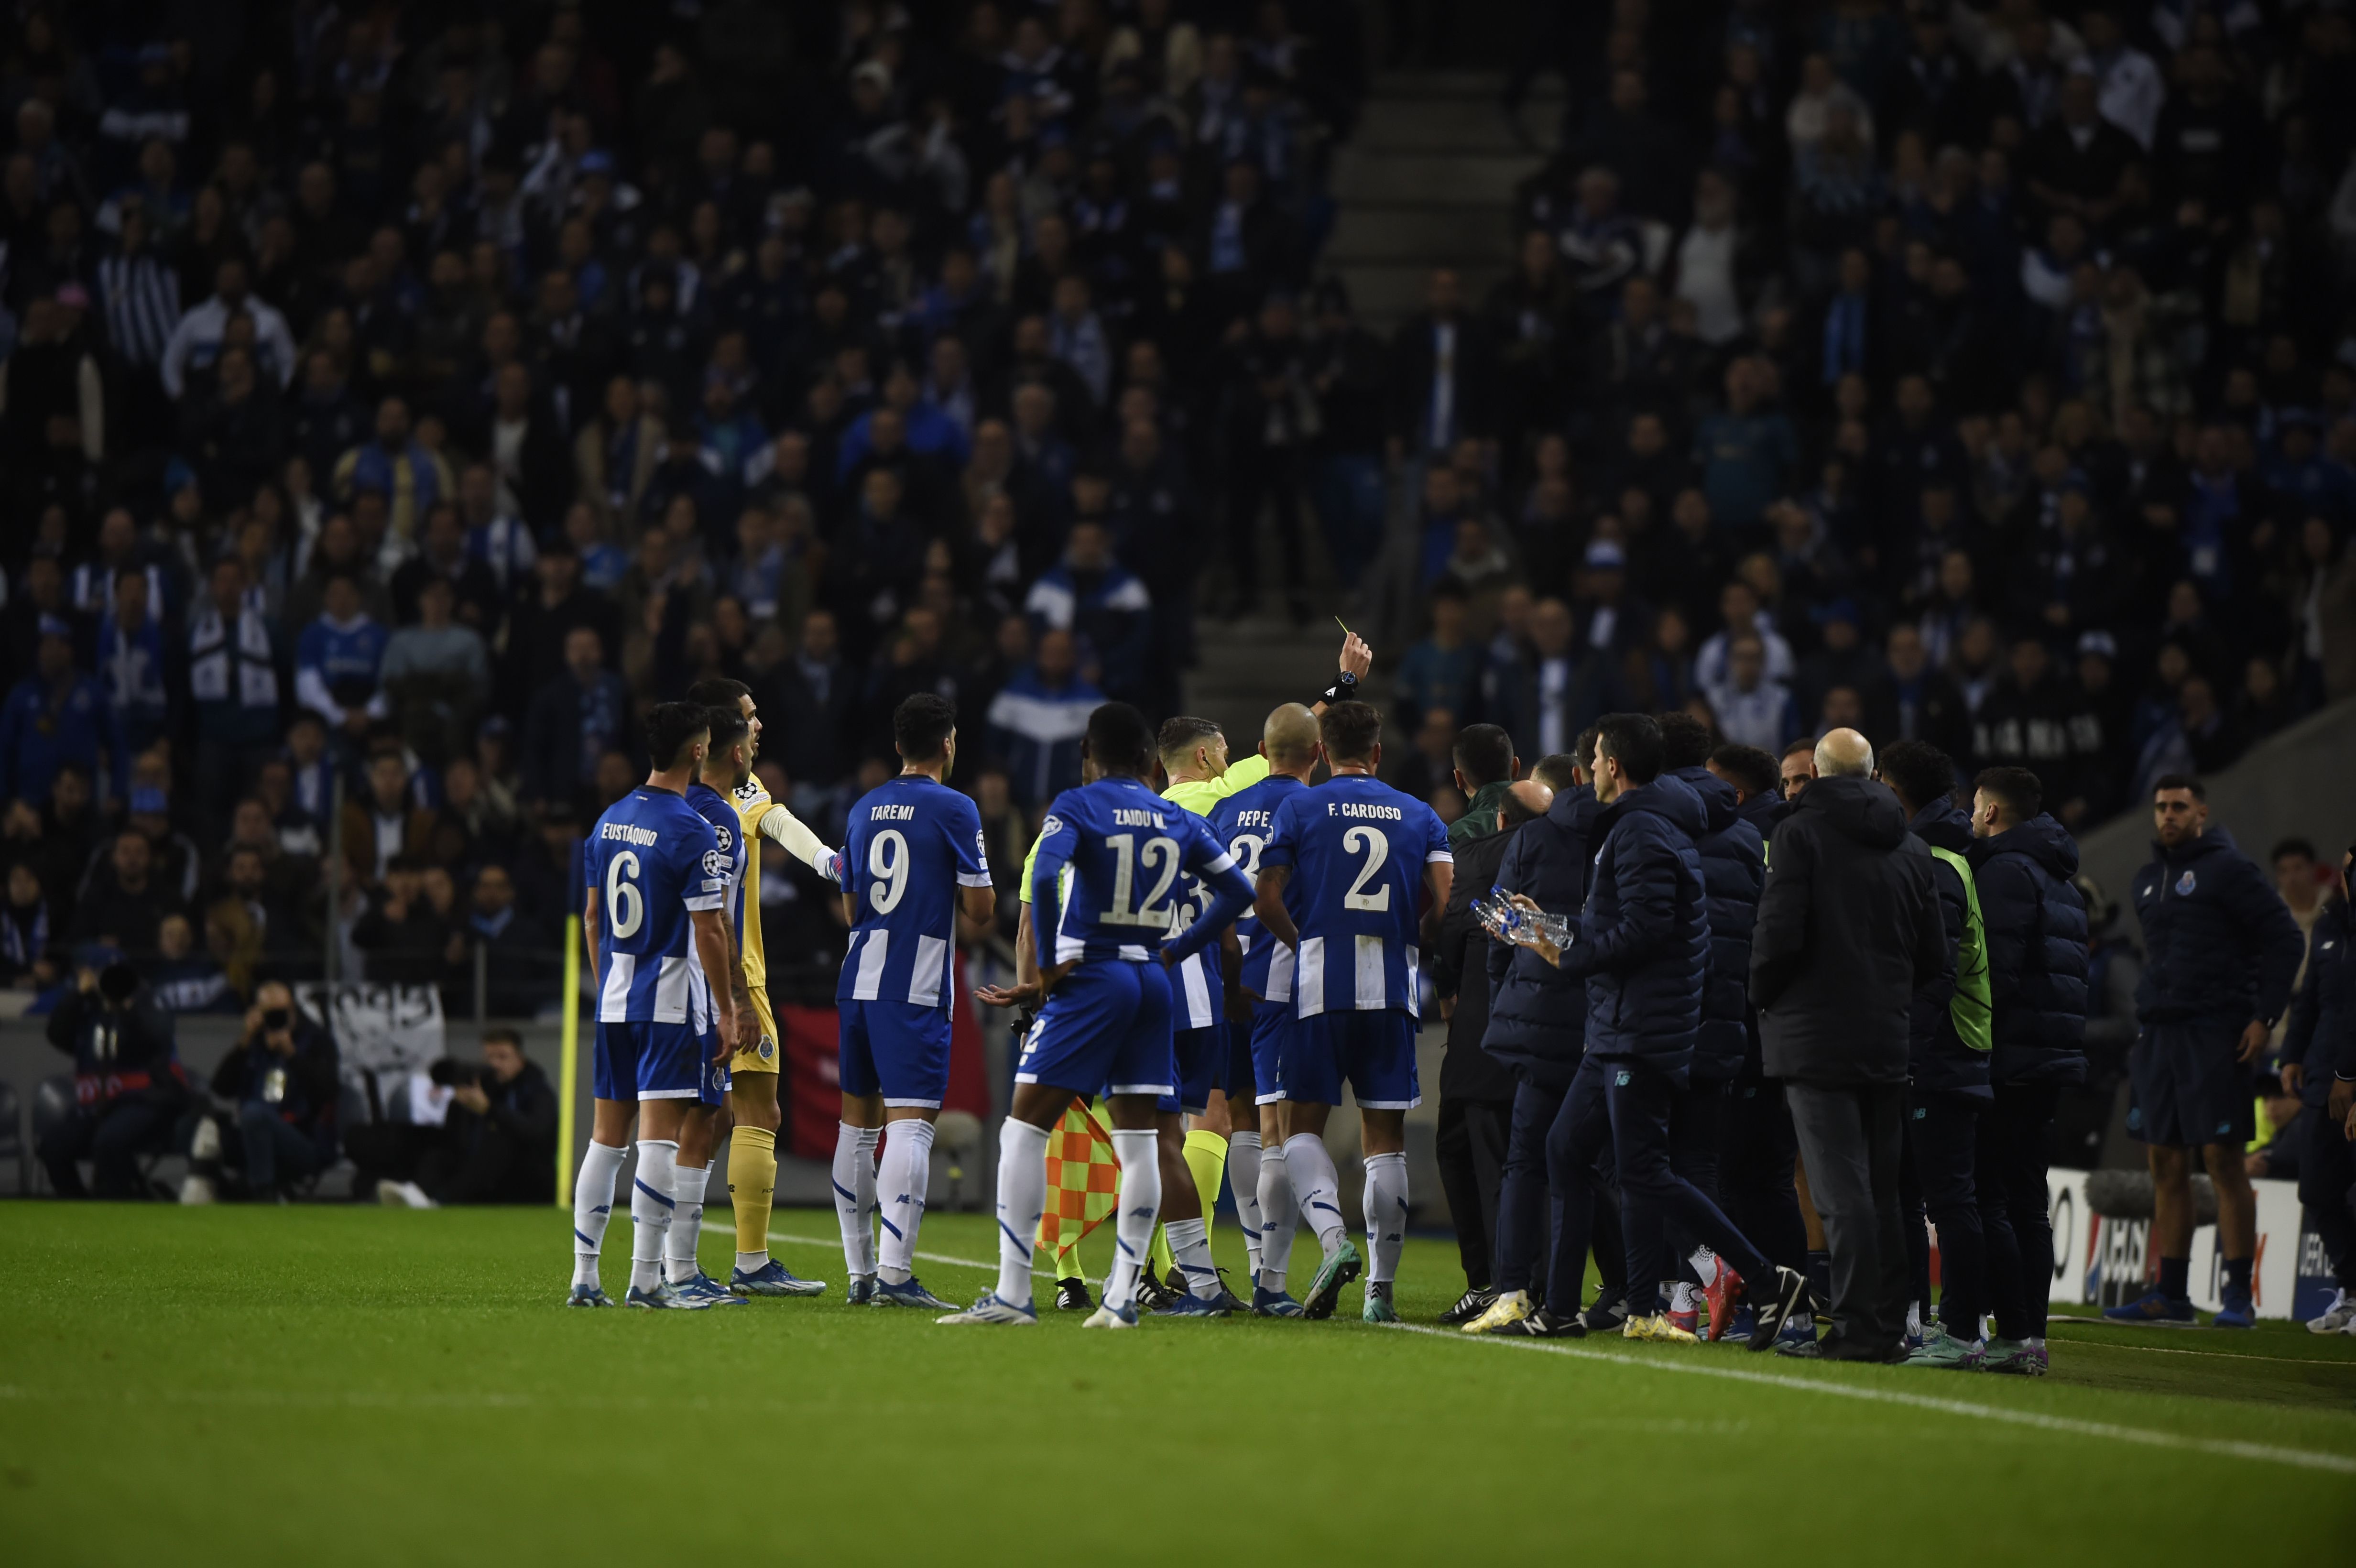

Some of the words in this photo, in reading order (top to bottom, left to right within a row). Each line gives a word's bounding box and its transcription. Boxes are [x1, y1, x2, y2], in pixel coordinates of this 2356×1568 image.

[601, 822, 658, 847] EUSTÁQUIO
[870, 804, 915, 821] TAREMI
[1112, 808, 1151, 828] ZAIDU
[1152, 812, 1167, 830] M.
[1237, 810, 1270, 828] PEPE
[1328, 803, 1338, 817] F.
[1342, 803, 1402, 821] CARDOSO
[607, 850, 644, 938] 6
[869, 829, 910, 916] 9
[1099, 833, 1181, 929] 12
[1230, 834, 1264, 919] 3
[1343, 826, 1390, 912] 2
